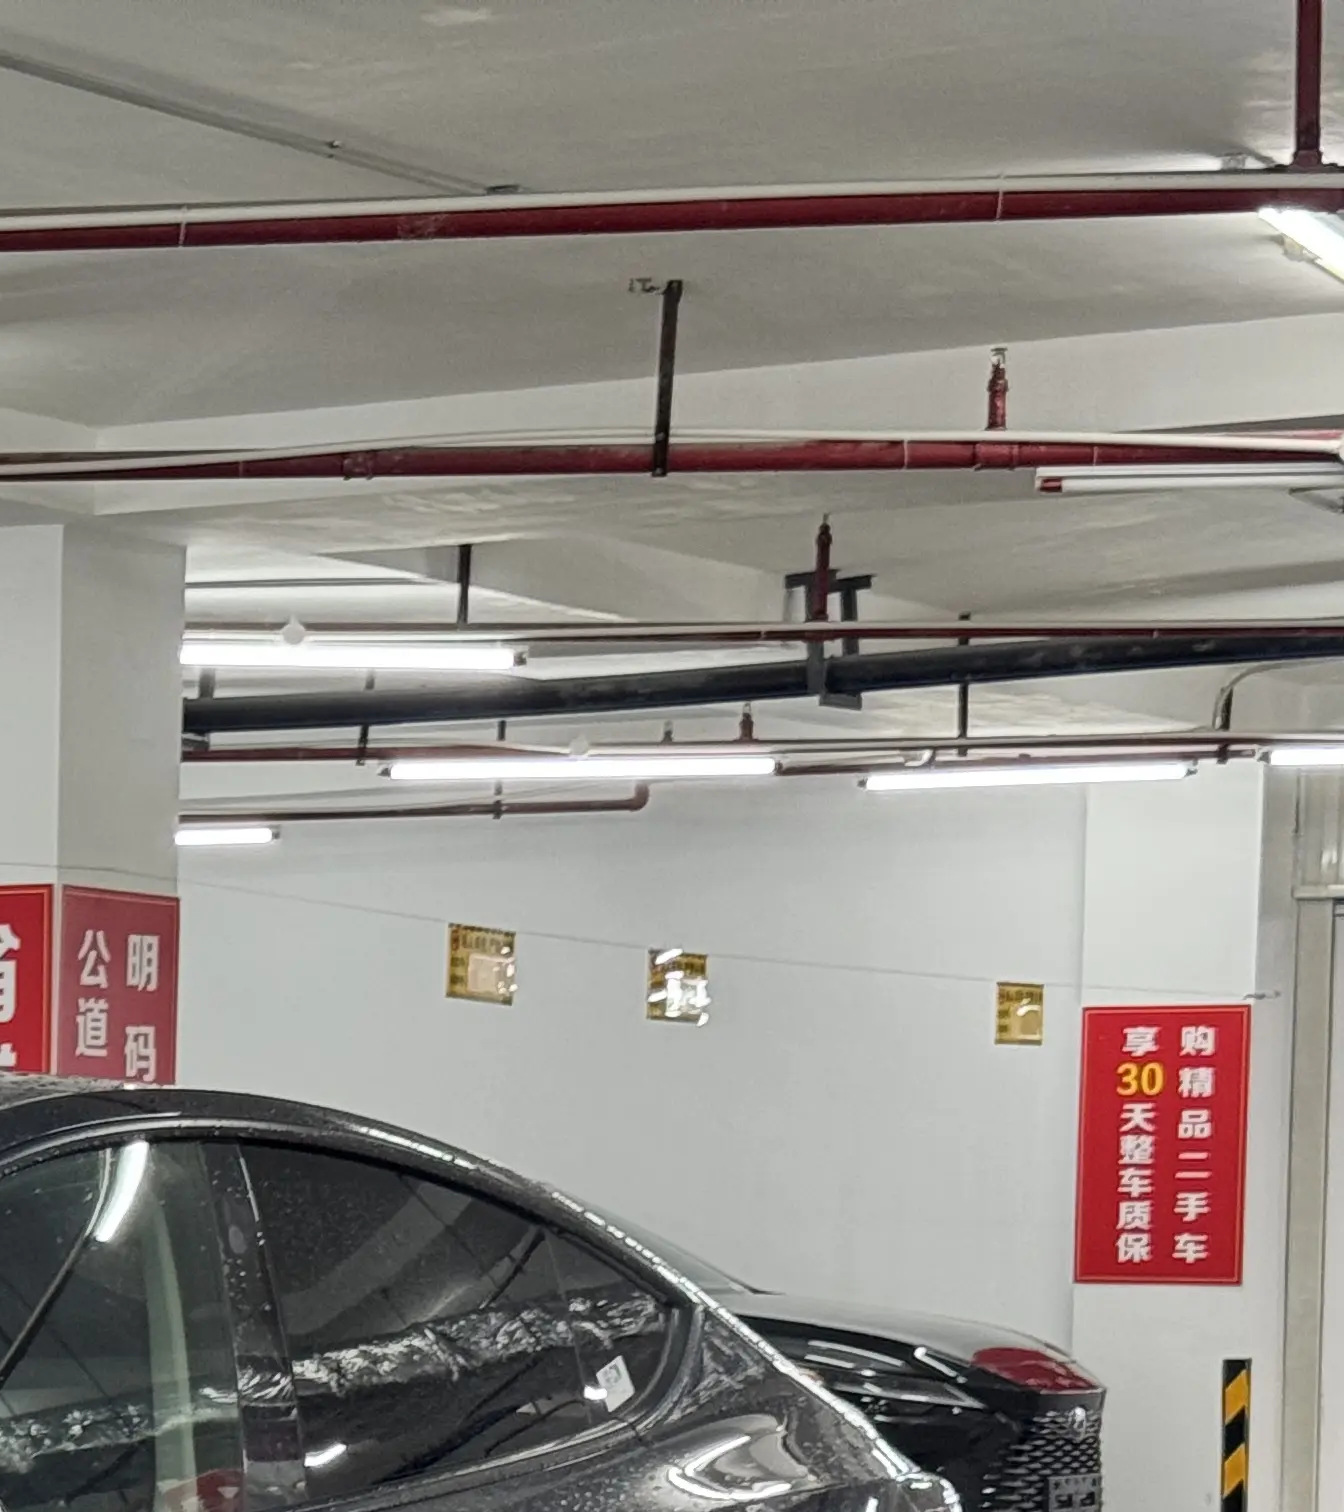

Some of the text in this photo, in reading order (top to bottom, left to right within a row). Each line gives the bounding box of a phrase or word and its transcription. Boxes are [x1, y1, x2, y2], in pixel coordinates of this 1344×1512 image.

[1172, 1025, 1216, 1264] 购精品二手车
